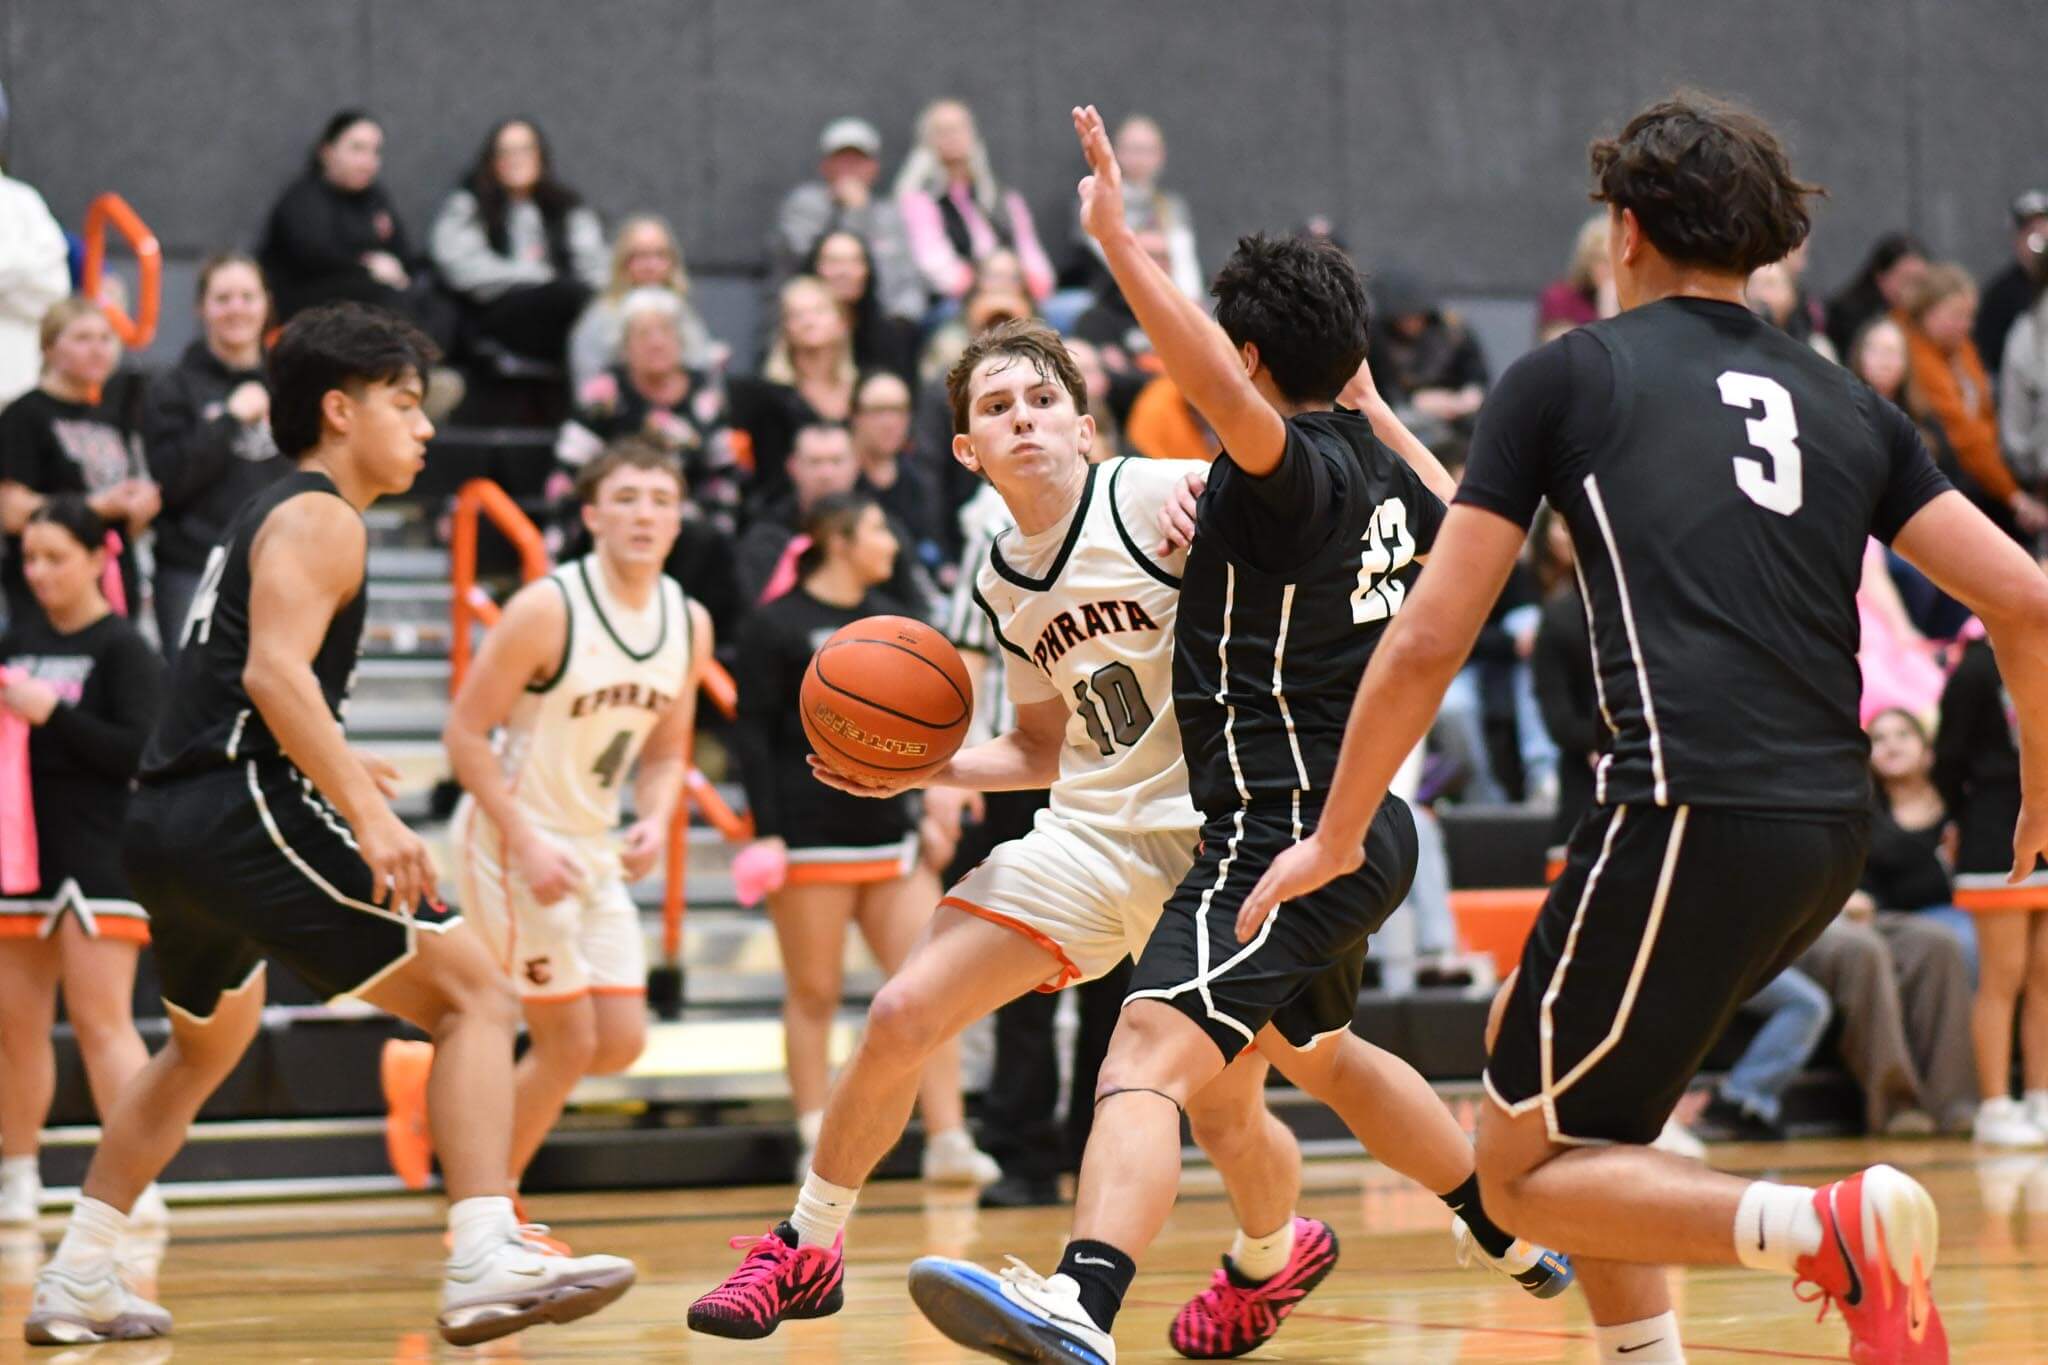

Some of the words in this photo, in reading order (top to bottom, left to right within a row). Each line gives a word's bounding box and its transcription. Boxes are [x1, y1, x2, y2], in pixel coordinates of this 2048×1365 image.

[1716, 370, 1803, 517] 3
[1350, 497, 1416, 625] 22
[1033, 600, 1160, 678] PHRATA
[1073, 661, 1155, 757] 10
[591, 730, 634, 788] 4
